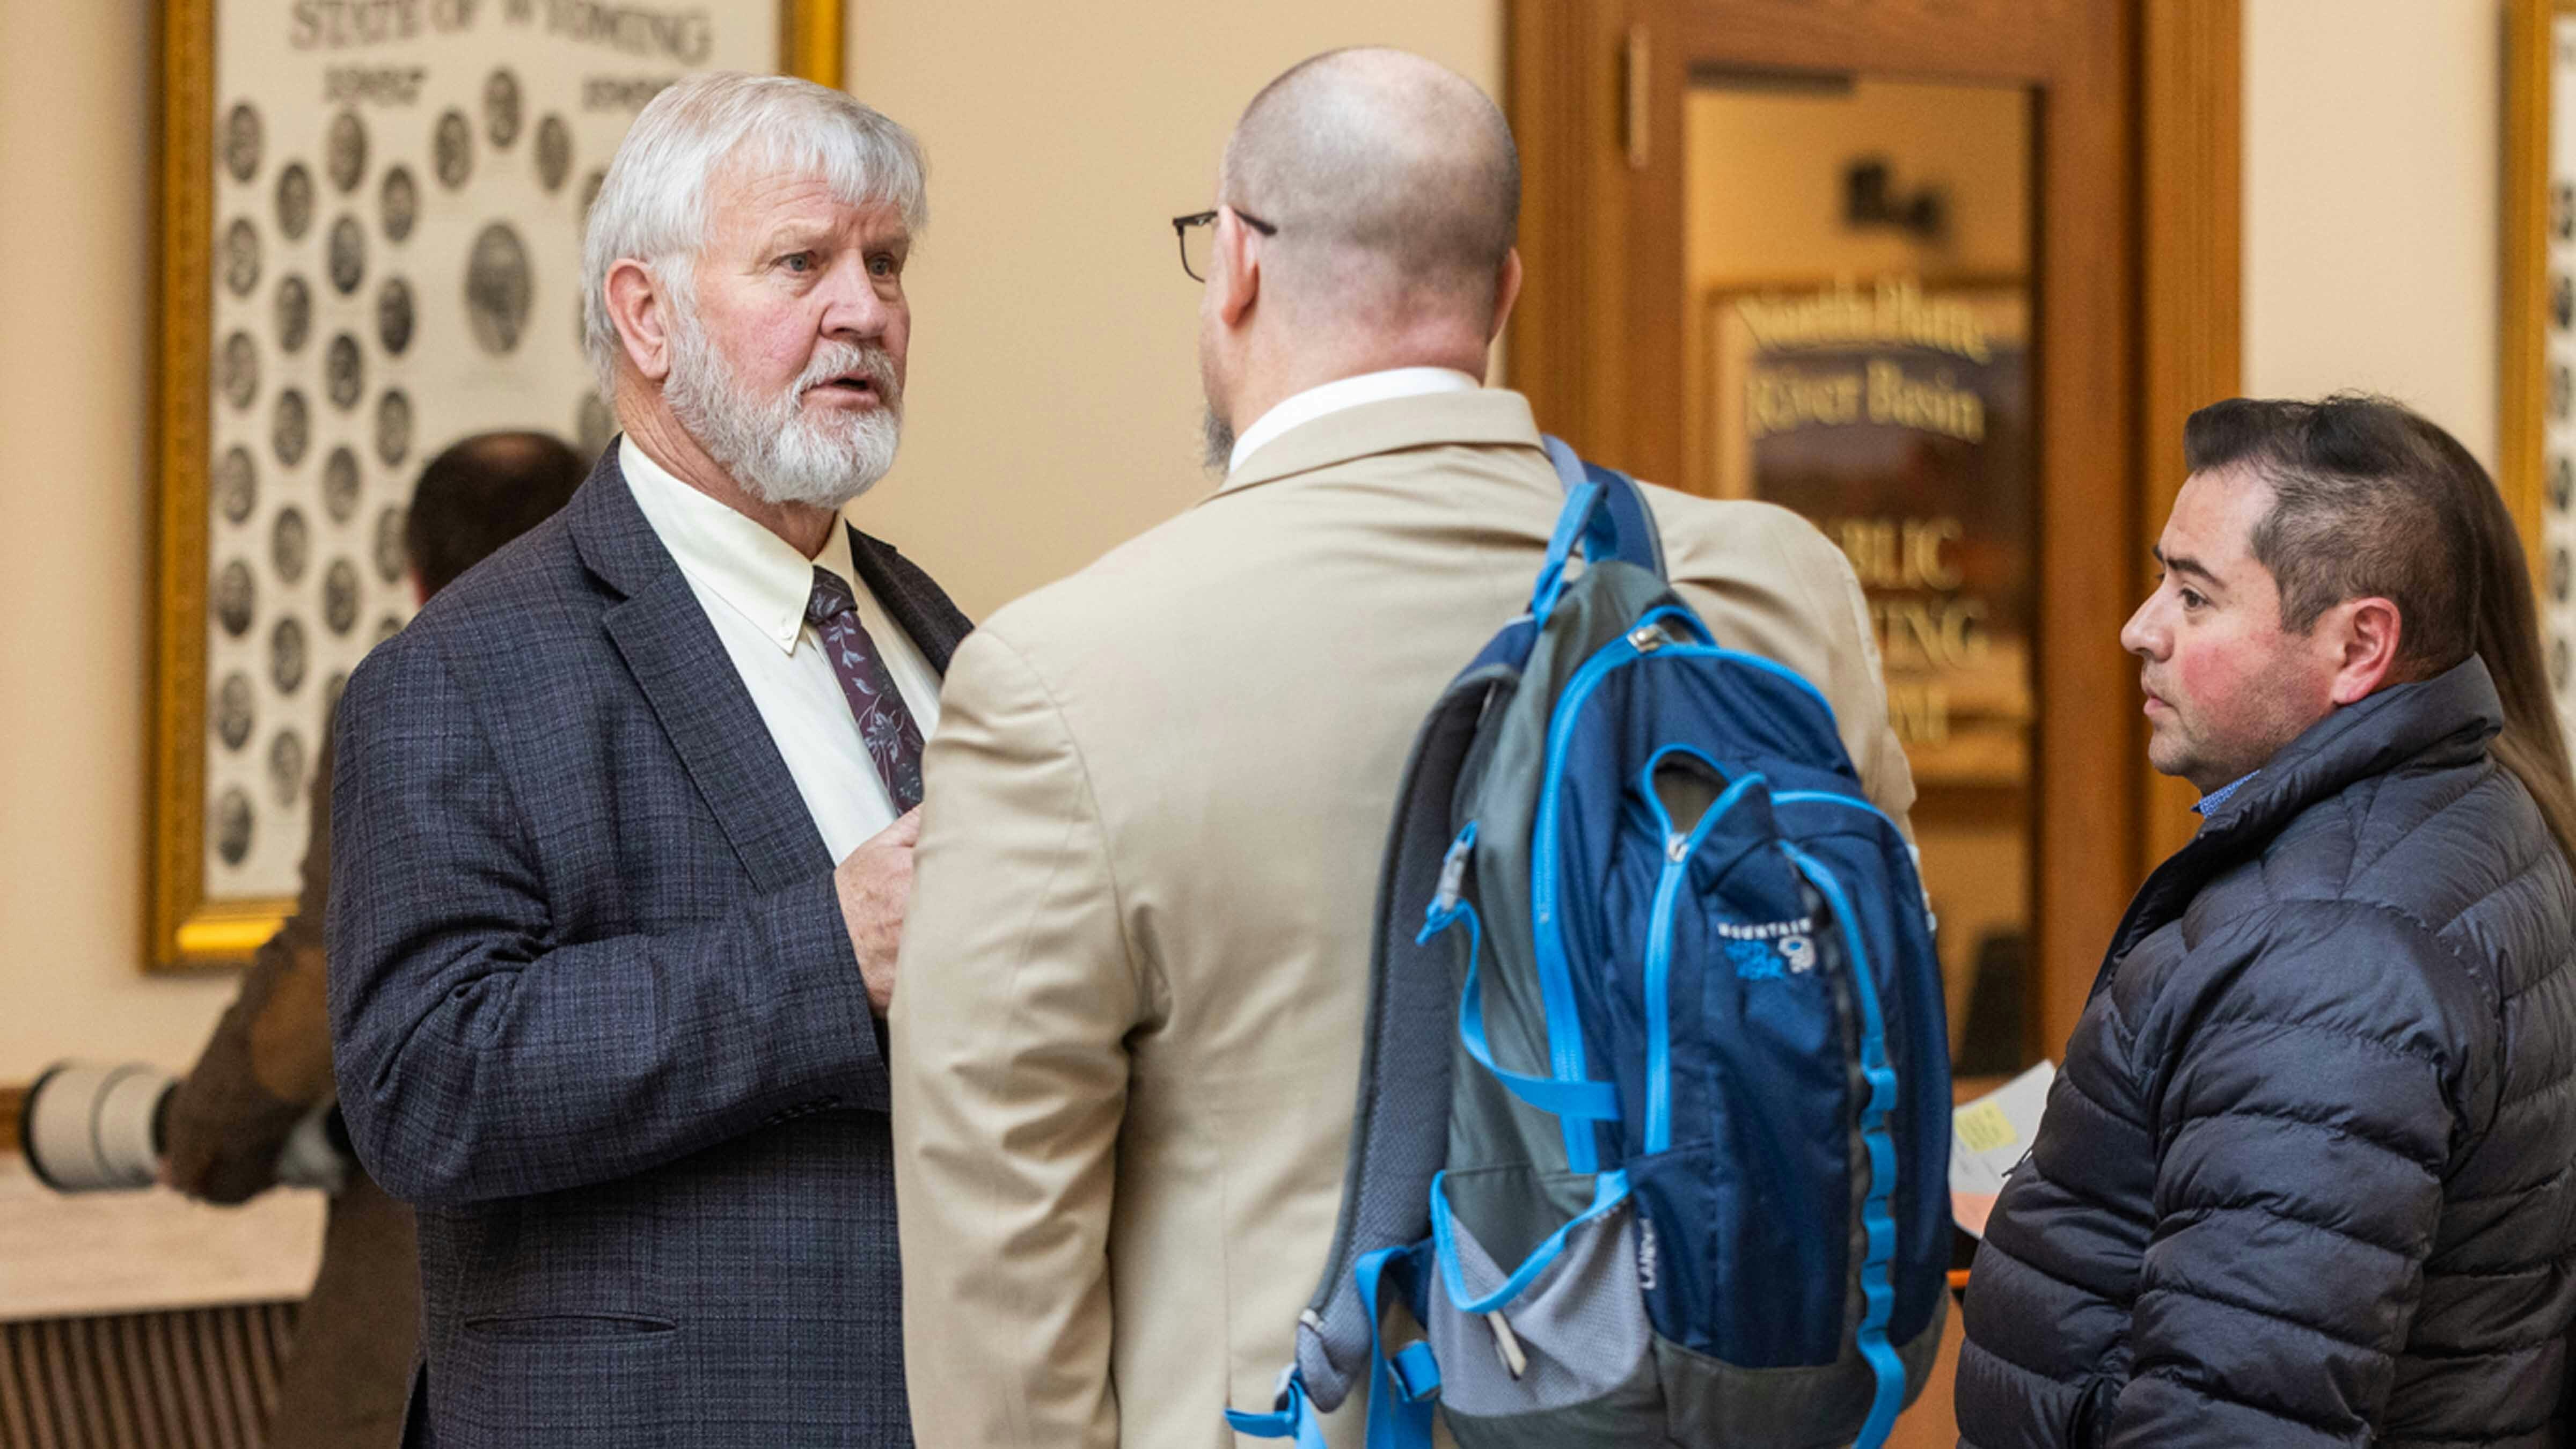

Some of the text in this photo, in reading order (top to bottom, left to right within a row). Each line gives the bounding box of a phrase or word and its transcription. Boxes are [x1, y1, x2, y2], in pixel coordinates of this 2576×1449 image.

[1743, 356, 1985, 444] River Basin
[1833, 516, 1965, 589] BLIC
[1718, 918, 1811, 940] MOUNTAIN
